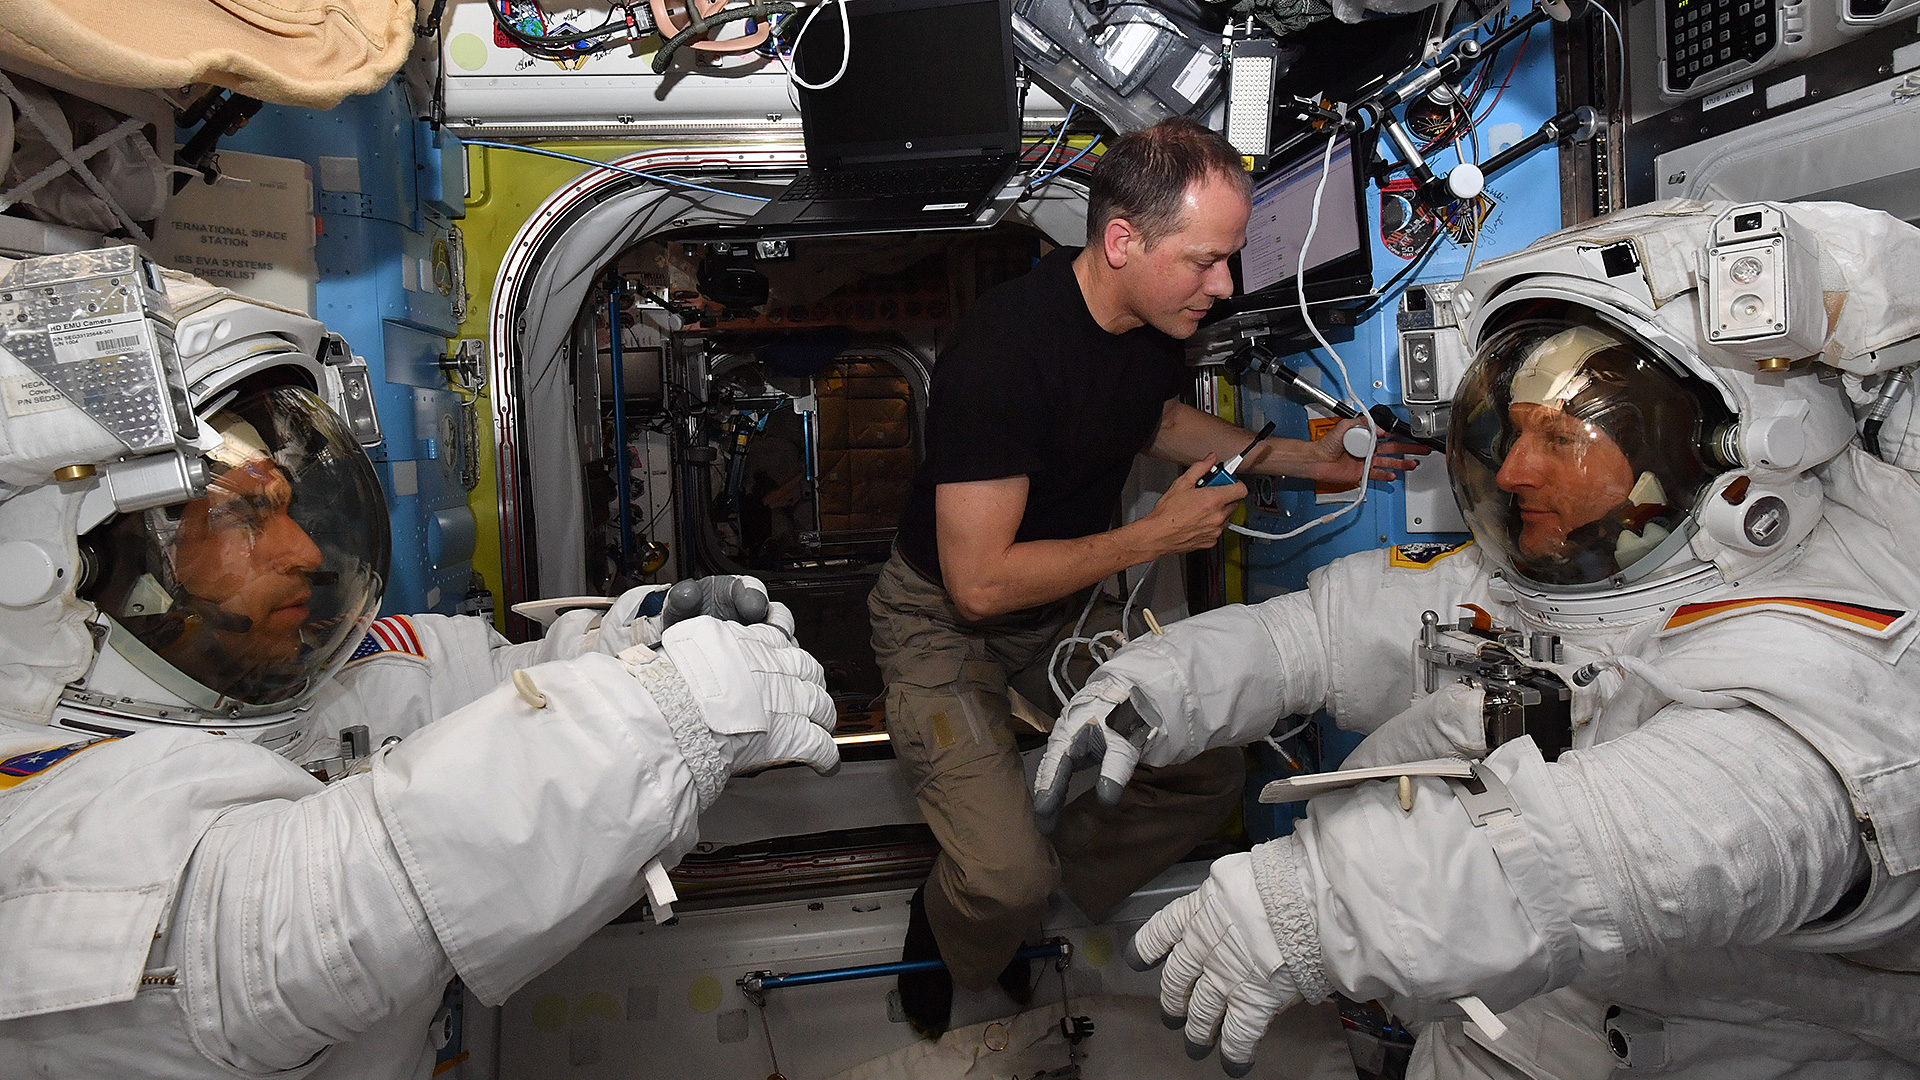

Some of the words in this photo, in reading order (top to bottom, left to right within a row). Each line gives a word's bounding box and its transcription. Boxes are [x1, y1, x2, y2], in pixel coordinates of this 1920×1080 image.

[251, 229, 287, 240] SPACE
[200, 236, 248, 247] STATION
[174, 254, 192, 264] ISS
[196, 256, 219, 266] EVA
[222, 258, 273, 270] SYSTEMS
[193, 267, 256, 280] CHECKLIST
[82, 318, 112, 327] Camera
[21, 381, 45, 389] HECA
